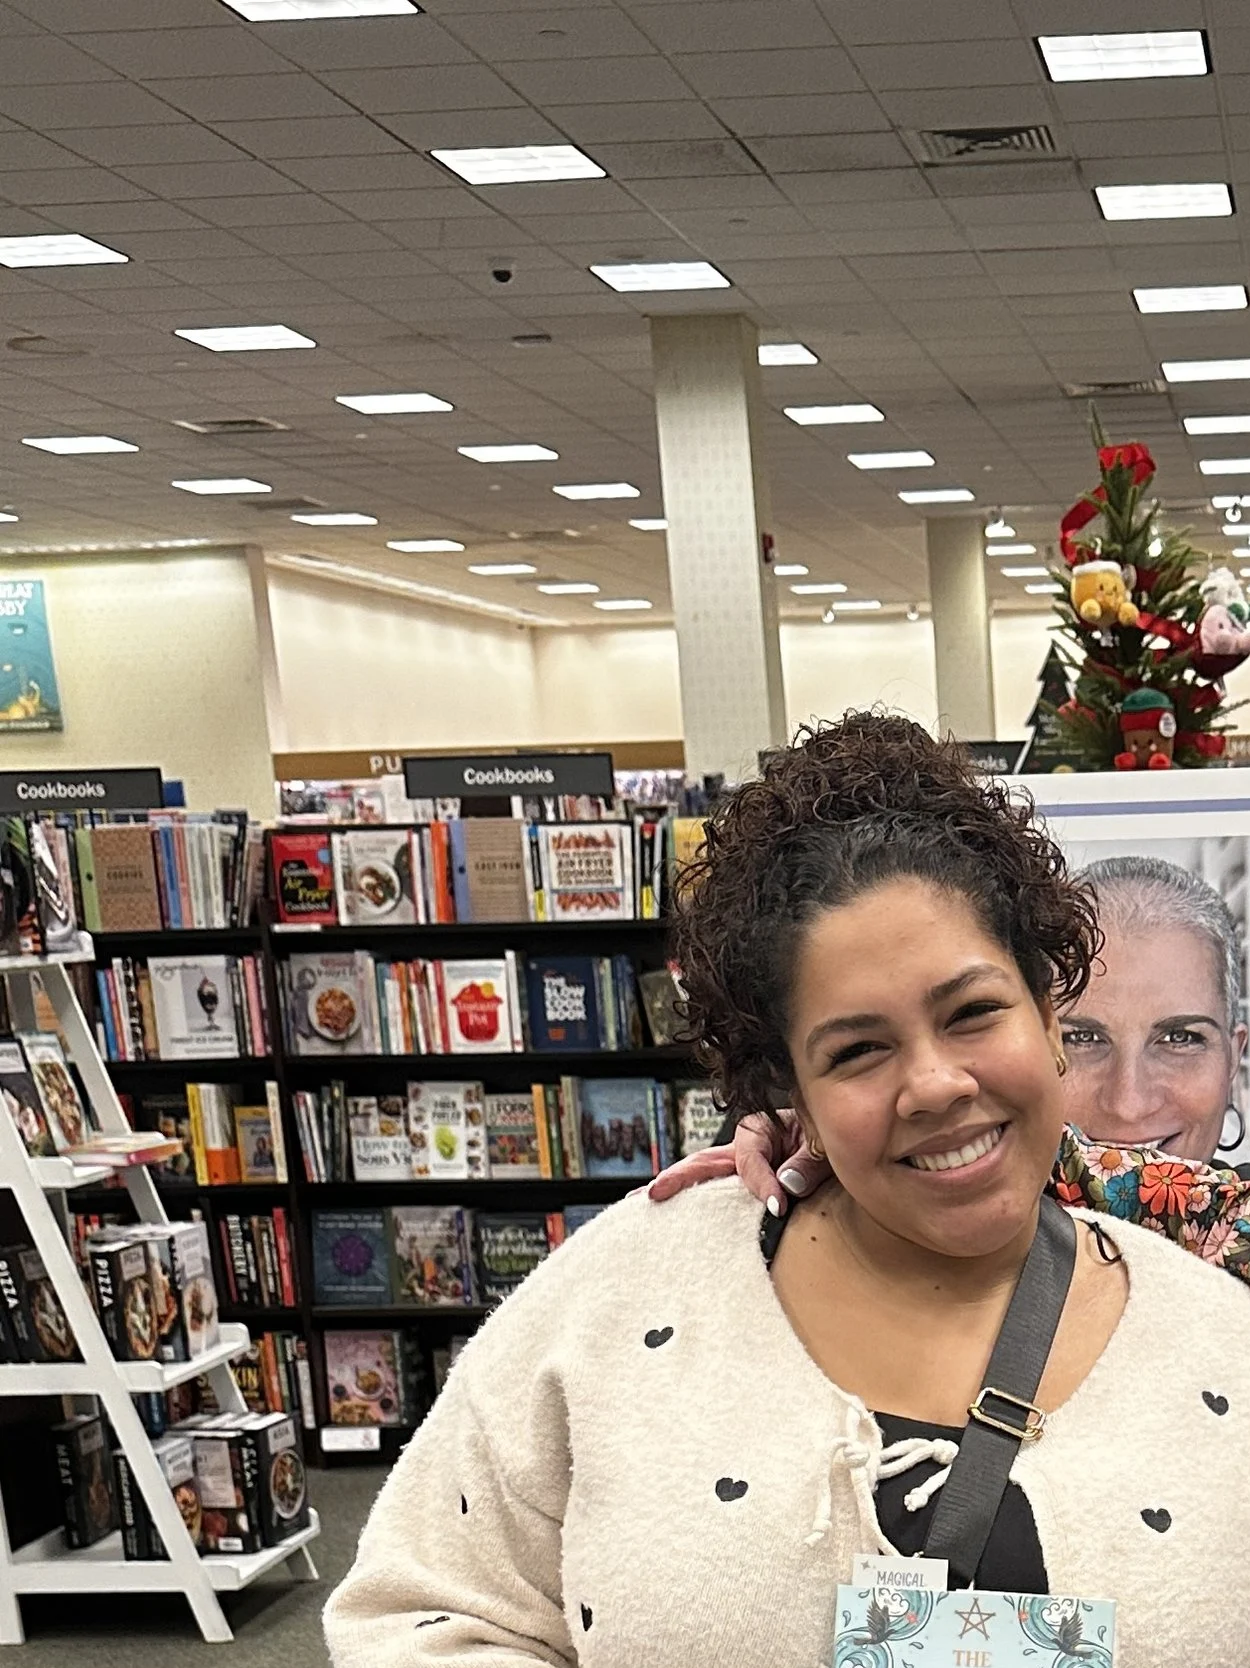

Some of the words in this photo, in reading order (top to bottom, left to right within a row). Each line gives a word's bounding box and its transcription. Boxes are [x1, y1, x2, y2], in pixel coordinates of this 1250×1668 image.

[463, 766, 555, 785] Cookbooks
[17, 781, 106, 800] Cookbooks
[95, 1258, 114, 1308] PIZZA
[952, 1649, 993, 1668] THE
